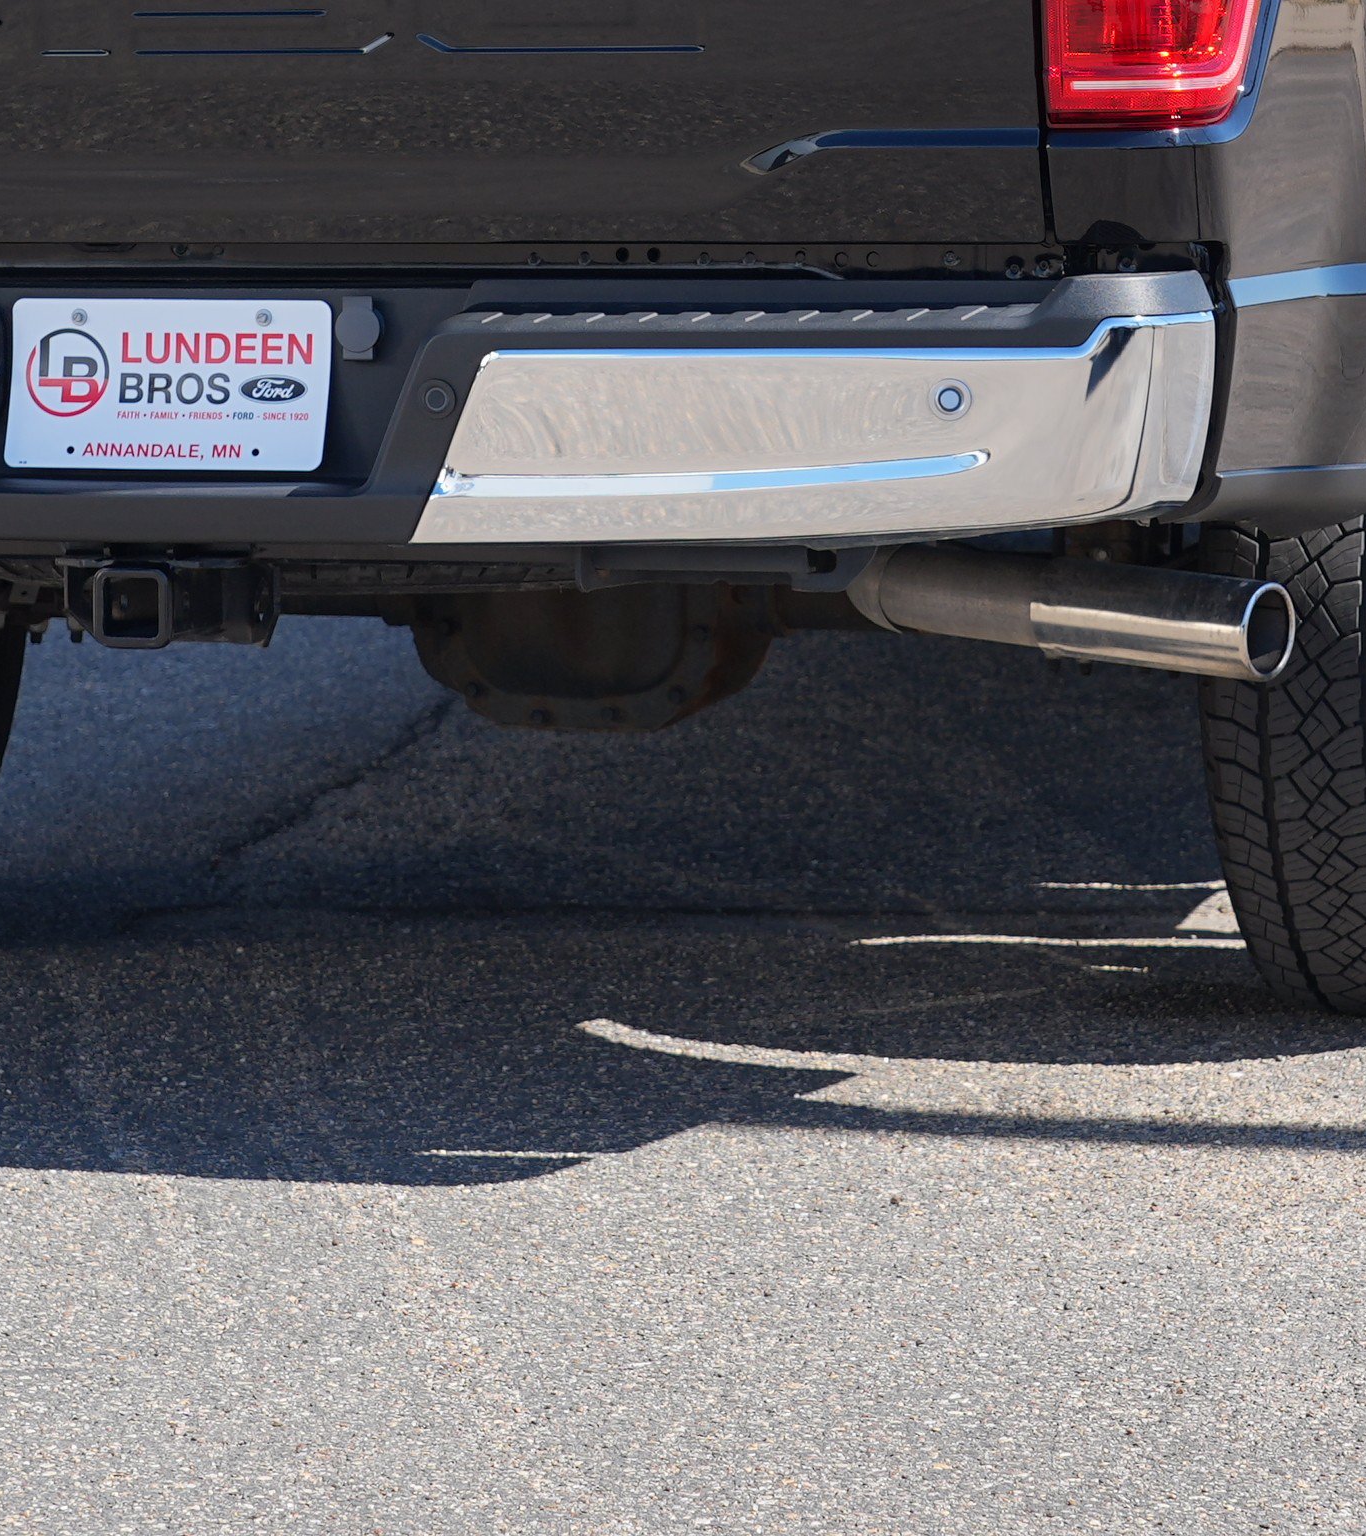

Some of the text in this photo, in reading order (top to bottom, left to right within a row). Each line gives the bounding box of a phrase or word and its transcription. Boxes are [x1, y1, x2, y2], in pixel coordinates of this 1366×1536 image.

[122, 332, 313, 364] LUNDEEN
[119, 373, 295, 405] BROS Ford
[116, 411, 309, 421] FAITH FAMILY FRIENDS FORD SINCE 1920
[82, 442, 242, 461] ANNANDALE, MN
